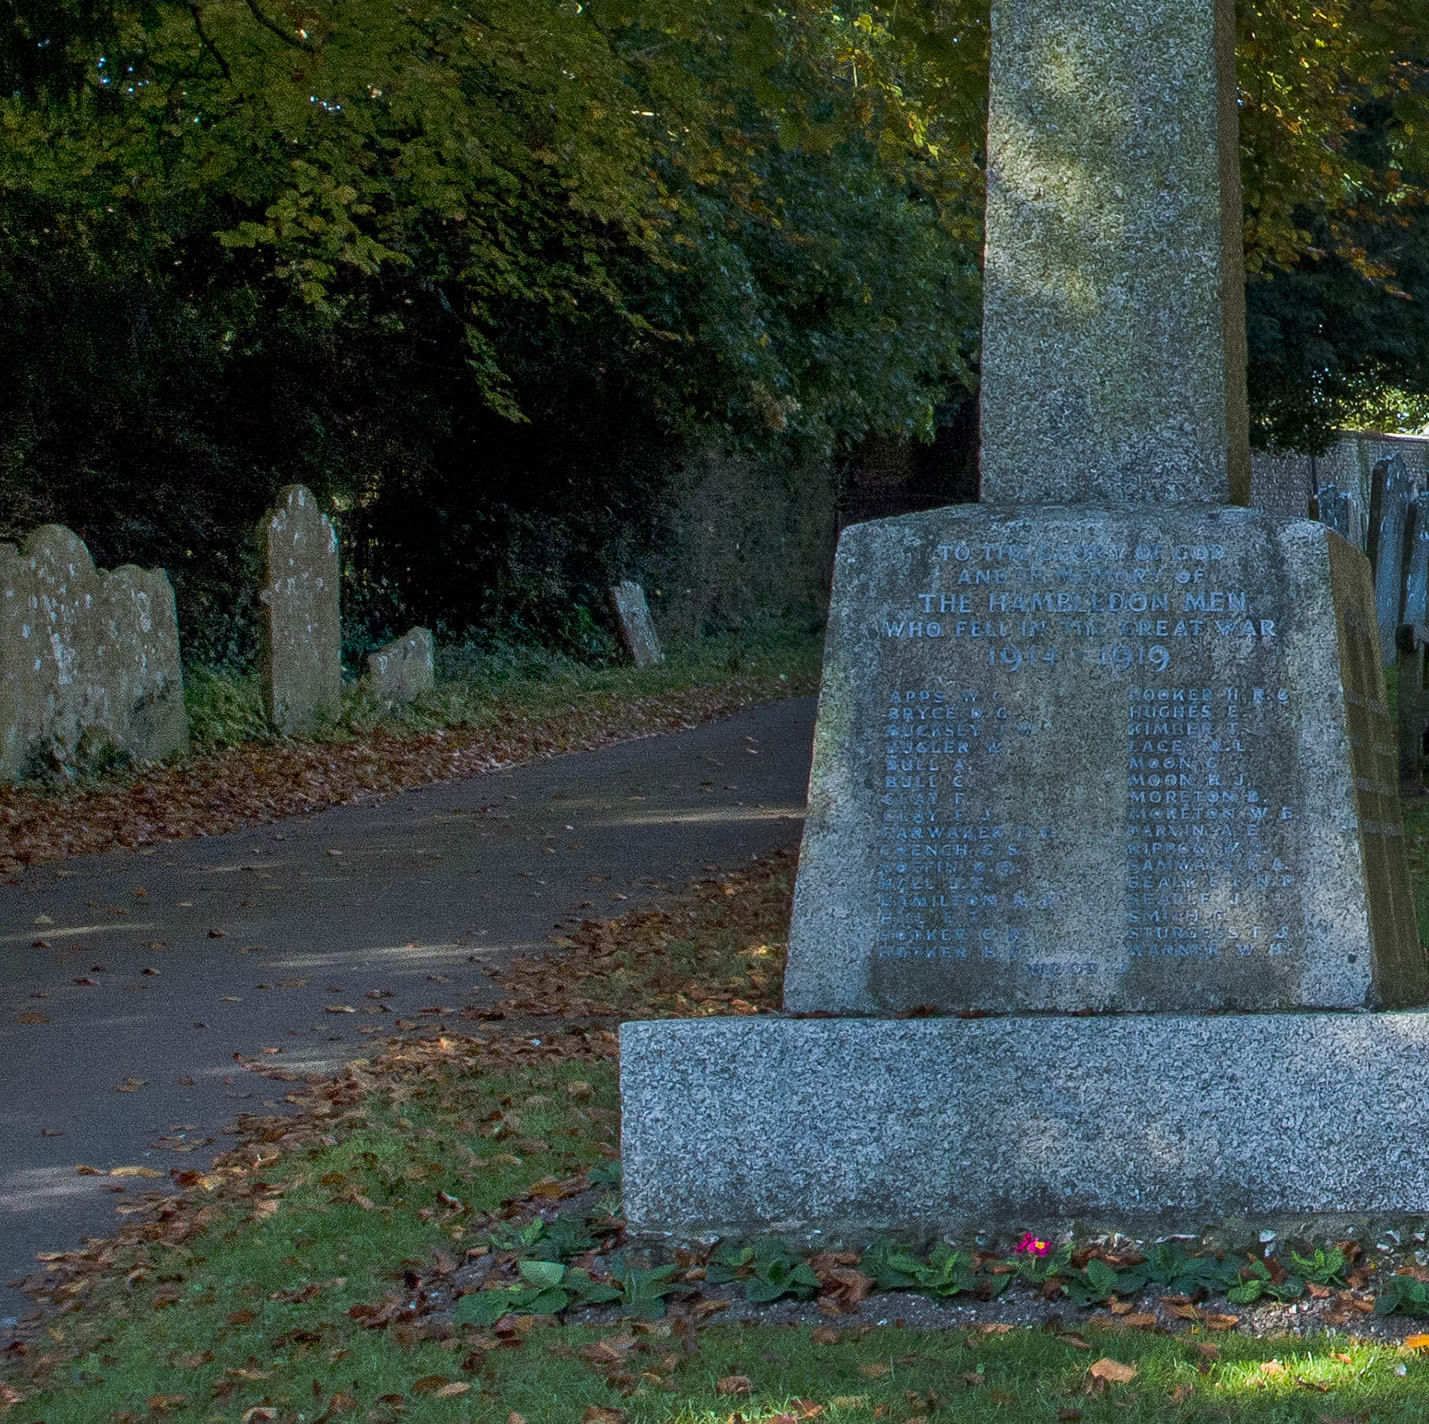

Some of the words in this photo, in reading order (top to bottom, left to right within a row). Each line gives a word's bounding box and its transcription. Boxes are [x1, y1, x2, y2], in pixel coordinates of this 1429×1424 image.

[938, 544, 970, 561] TO
[1135, 544, 1164, 561] OF
[1174, 544, 1226, 561] GOD
[957, 568, 1008, 585] AND
[1174, 568, 1206, 584] OF
[918, 592, 973, 614] THE
[988, 592, 1170, 614] HAMBLEDON
[1184, 591, 1247, 613] MEN
[882, 621, 942, 638] WHO
[955, 620, 1008, 638] FELL
[1020, 620, 1047, 637] IN
[1120, 619, 1205, 637] GREAT
[1215, 619, 1277, 637] WAR
[987, 644, 1058, 672] 1914
[1099, 644, 1171, 672] 1919
[889, 690, 945, 703] APPS
[1128, 688, 1214, 703] HOOKER
[888, 707, 957, 720] BRYCE
[1129, 705, 1213, 719] HUGHES
[1128, 722, 1213, 736] KIMBER
[886, 758, 939, 771] BULL
[1129, 756, 1194, 770] MOON
[885, 775, 938, 788] BULL
[1128, 773, 1194, 787] MOON
[1129, 790, 1235, 804] MORETON
[1129, 807, 1236, 820] MORETON
[879, 894, 998, 908] HAMILTON
